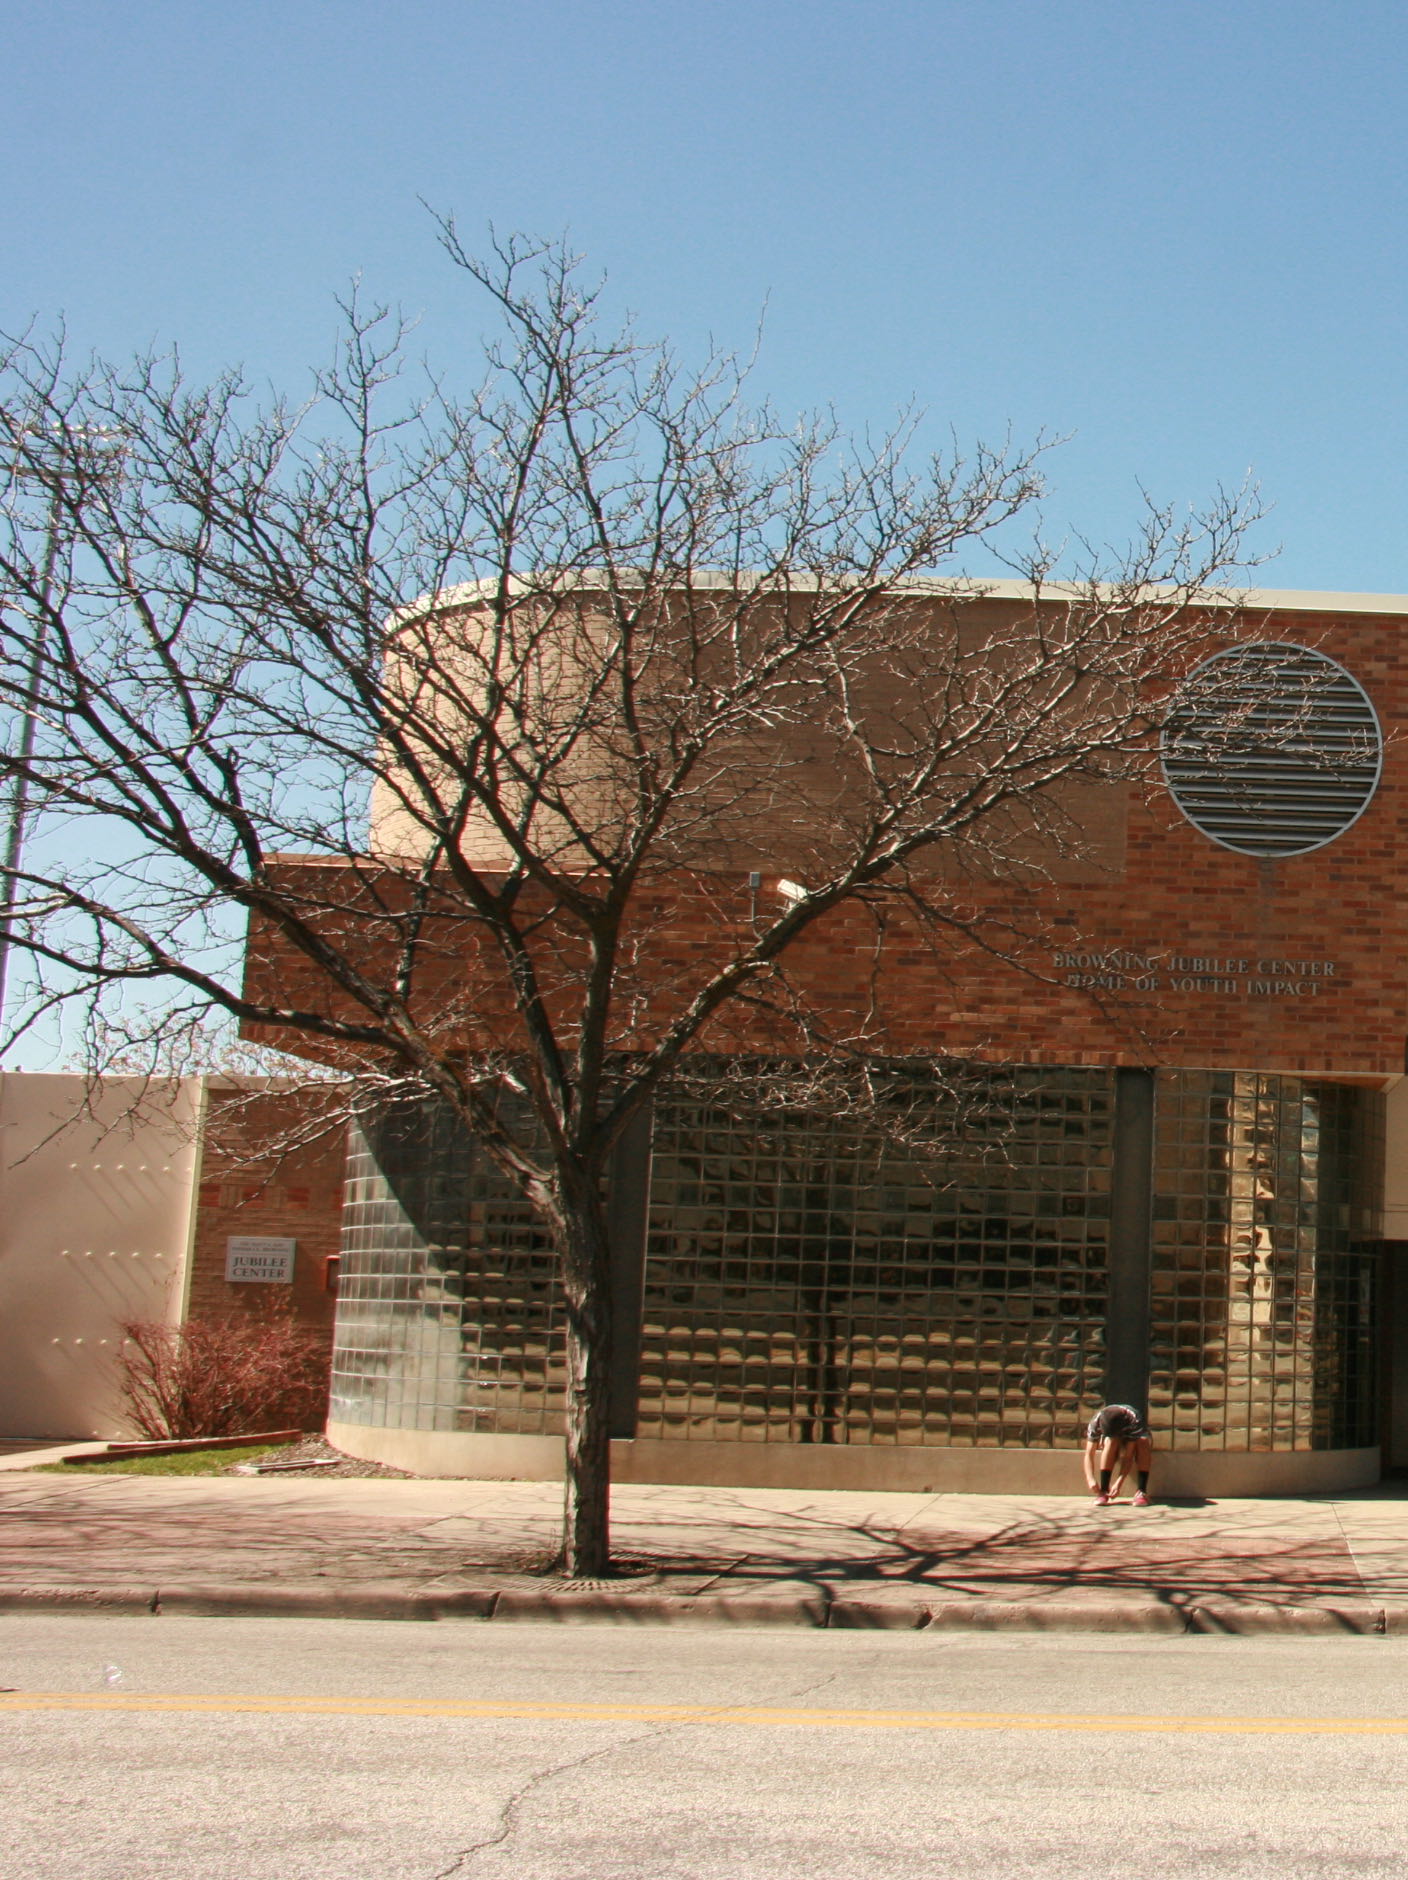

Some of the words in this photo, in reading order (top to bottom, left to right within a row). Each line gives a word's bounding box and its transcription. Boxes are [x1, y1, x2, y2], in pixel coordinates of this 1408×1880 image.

[1052, 953, 1159, 970] BROWNING
[1167, 957, 1249, 973] JUBILEE
[1257, 959, 1335, 977] CENTER
[1136, 977, 1160, 991] OF
[1170, 978, 1238, 994] YOUTH
[1247, 980, 1321, 996] IMPACT
[232, 1256, 288, 1267] JUBILEE
[232, 1268, 285, 1278] CENTER
